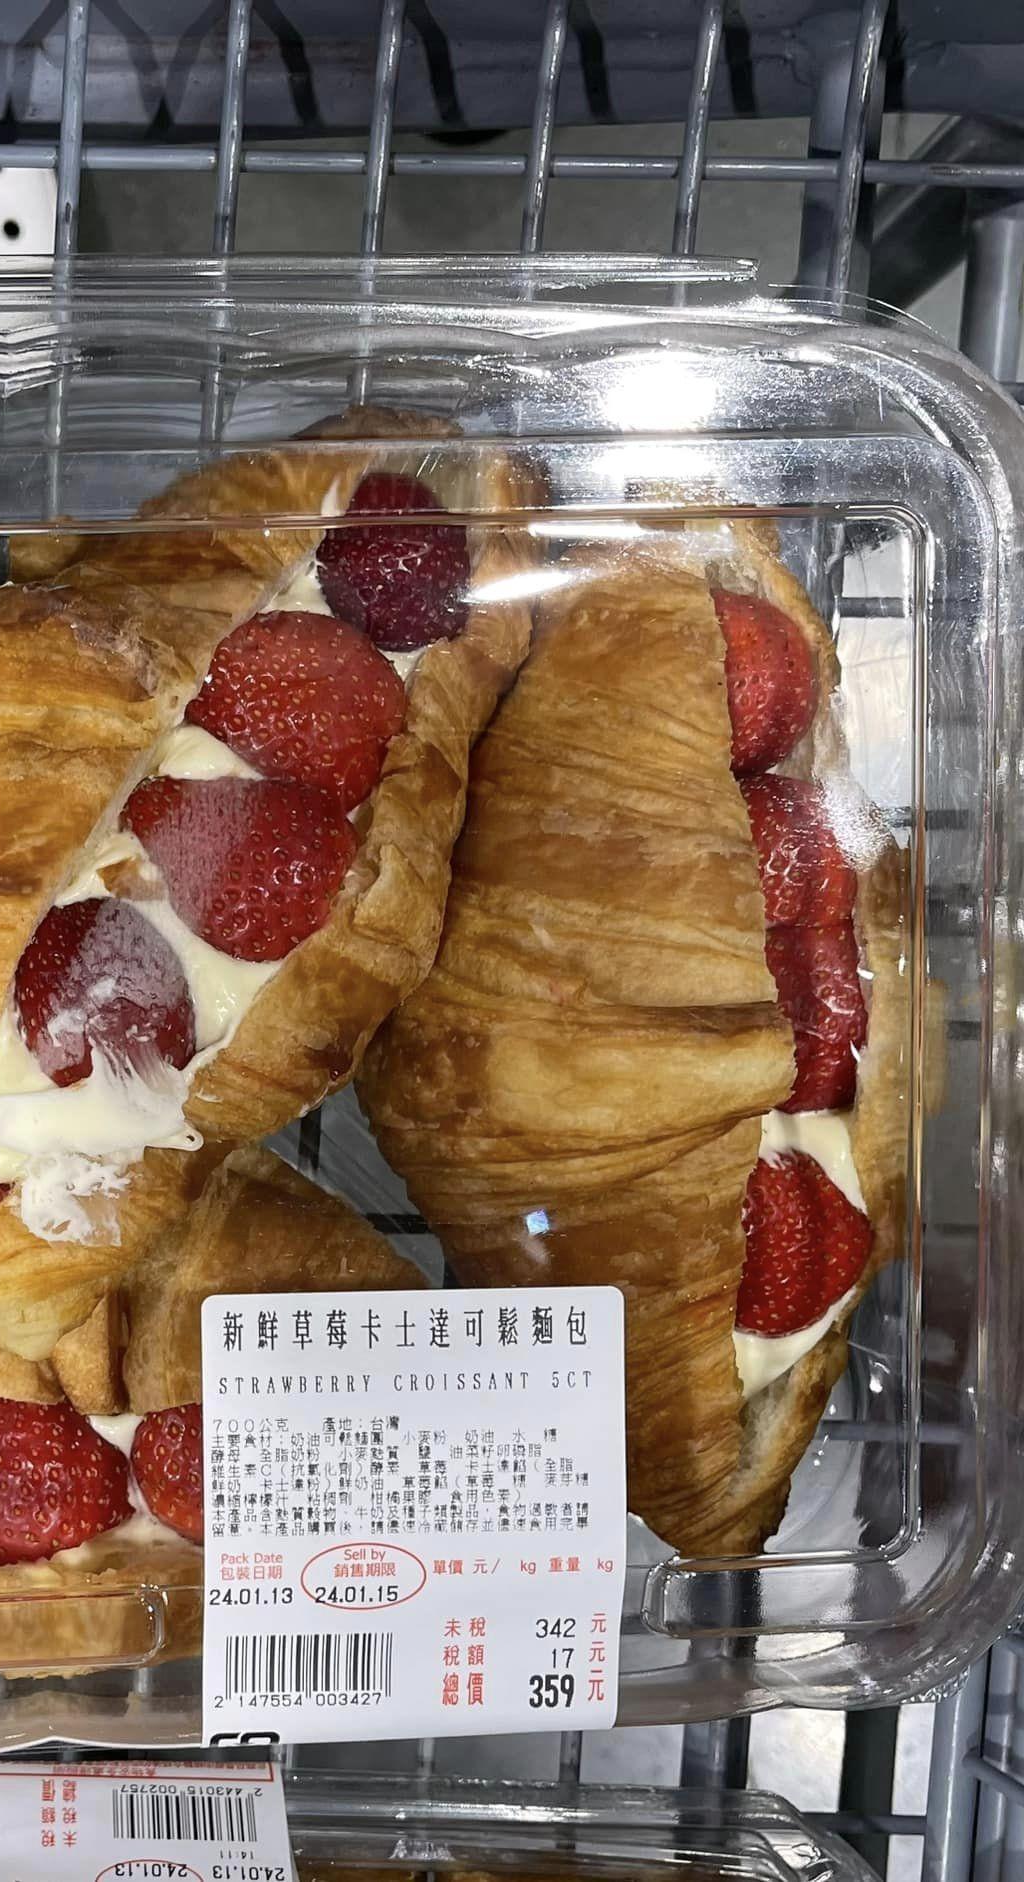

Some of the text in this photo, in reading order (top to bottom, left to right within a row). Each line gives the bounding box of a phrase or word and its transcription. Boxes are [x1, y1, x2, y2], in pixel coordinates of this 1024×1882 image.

[224, 1306, 586, 1351] 新鮮草莓卡士達可鬆麵包
[219, 1371, 591, 1394] STRAWBERRY CROISSANT 5CT
[465, 1428, 494, 1442] 奶油
[513, 1427, 526, 1441] 水
[221, 1553, 283, 1564] Pack Date
[344, 1549, 385, 1562] Sell by
[221, 1563, 282, 1580] 包裝日期
[334, 1563, 395, 1577] 銷售期限
[433, 1560, 463, 1575] 單價
[521, 1560, 536, 1574] kg
[549, 1557, 579, 1572] 重量
[597, 1558, 613, 1572] kg
[210, 1588, 292, 1605] 24.01.13
[315, 1586, 399, 1603] 24.01.15
[536, 1618, 576, 1638] 342
[591, 1613, 606, 1632] 元
[552, 1648, 574, 1668] 17
[589, 1641, 605, 1662] 元
[530, 1674, 574, 1708] 359
[588, 1670, 604, 1701] 元
[215, 1692, 381, 1708] 2 147554 003427
[120, 1784, 262, 1797] 2 443015 002757
[115, 1864, 187, 1876] 24.01.13
[213, 1866, 284, 1880] 24.01.13
